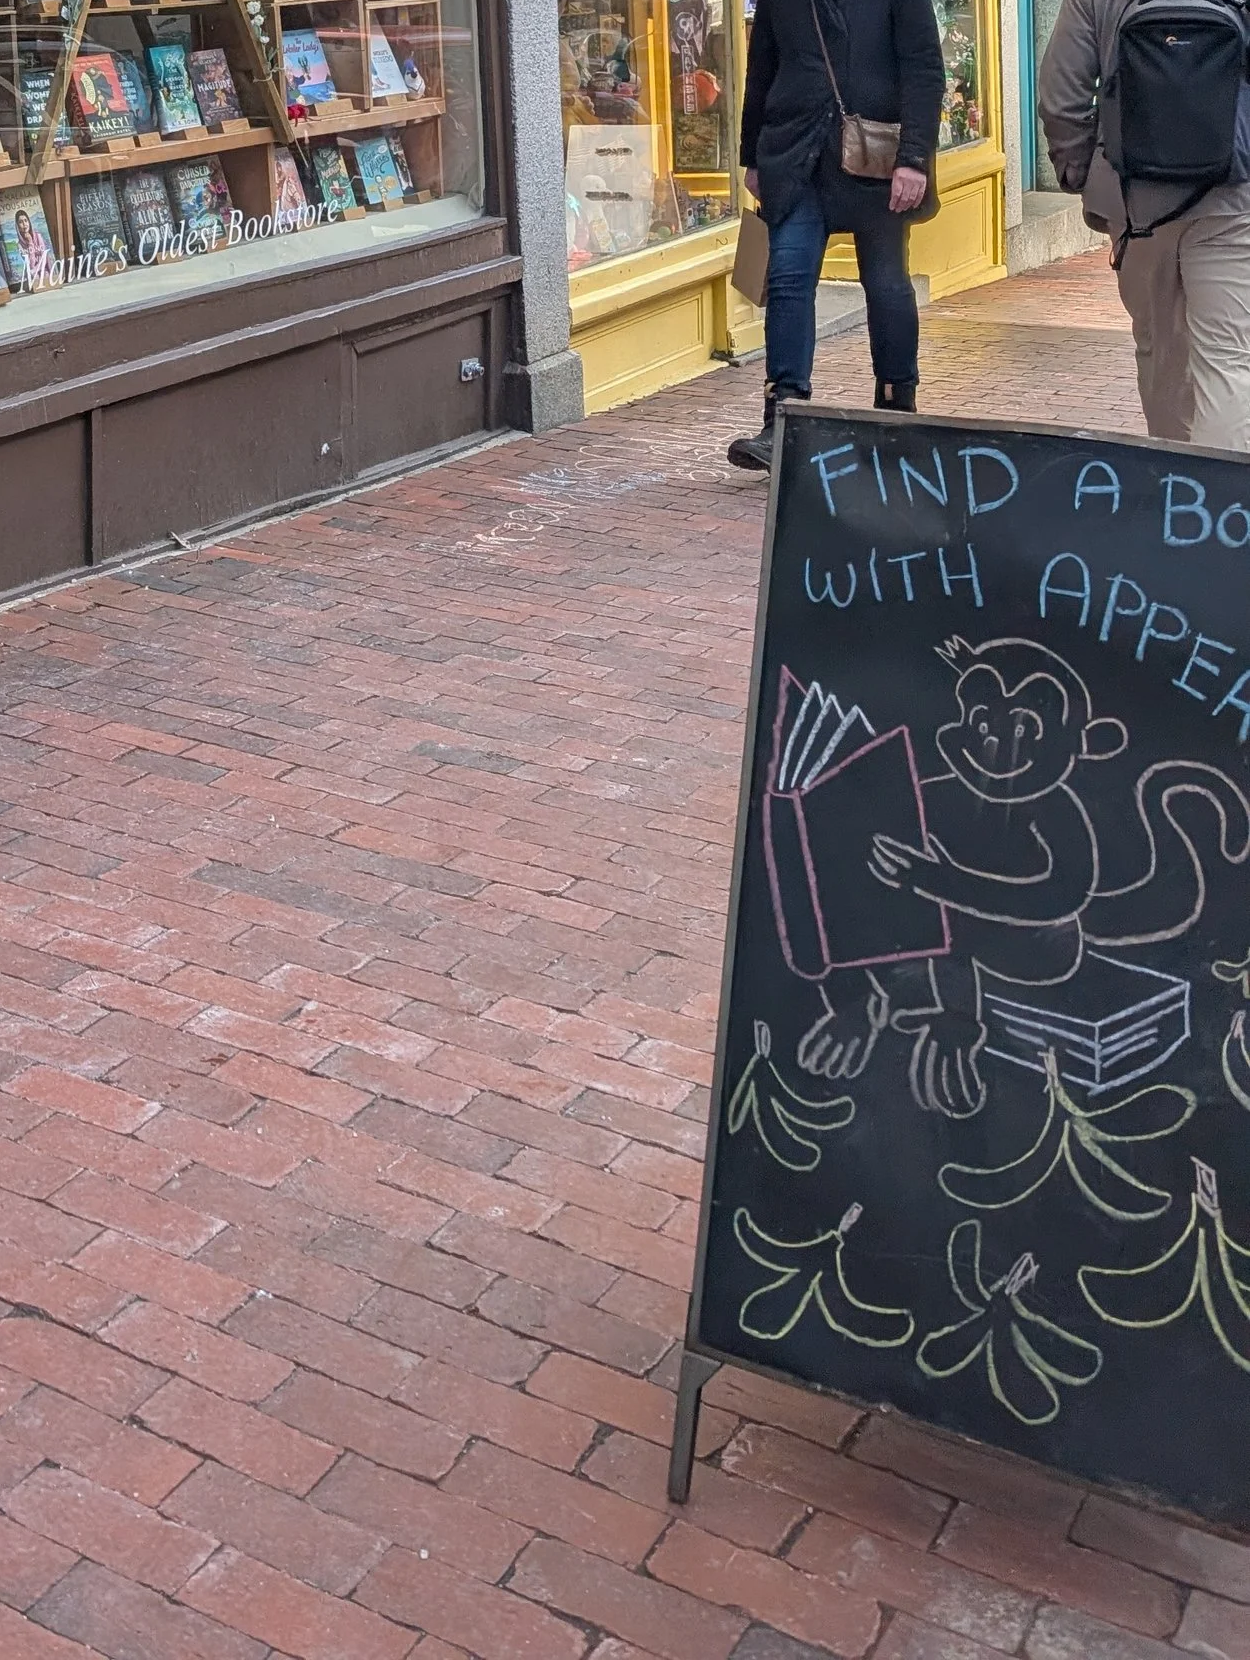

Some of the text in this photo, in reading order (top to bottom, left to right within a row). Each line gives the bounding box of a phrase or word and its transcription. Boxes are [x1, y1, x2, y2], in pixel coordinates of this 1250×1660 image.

[26, 79, 50, 89] WHEN
[177, 165, 210, 180] CURSED
[79, 191, 105, 203] FIFTH
[76, 201, 112, 213] SEASON
[17, 233, 129, 294] Maine's
[138, 219, 219, 265] Oldest
[226, 198, 339, 247] Bookstore
[810, 443, 1020, 518] FIND
[1074, 460, 1122, 515] A
[804, 542, 985, 610] WITH
